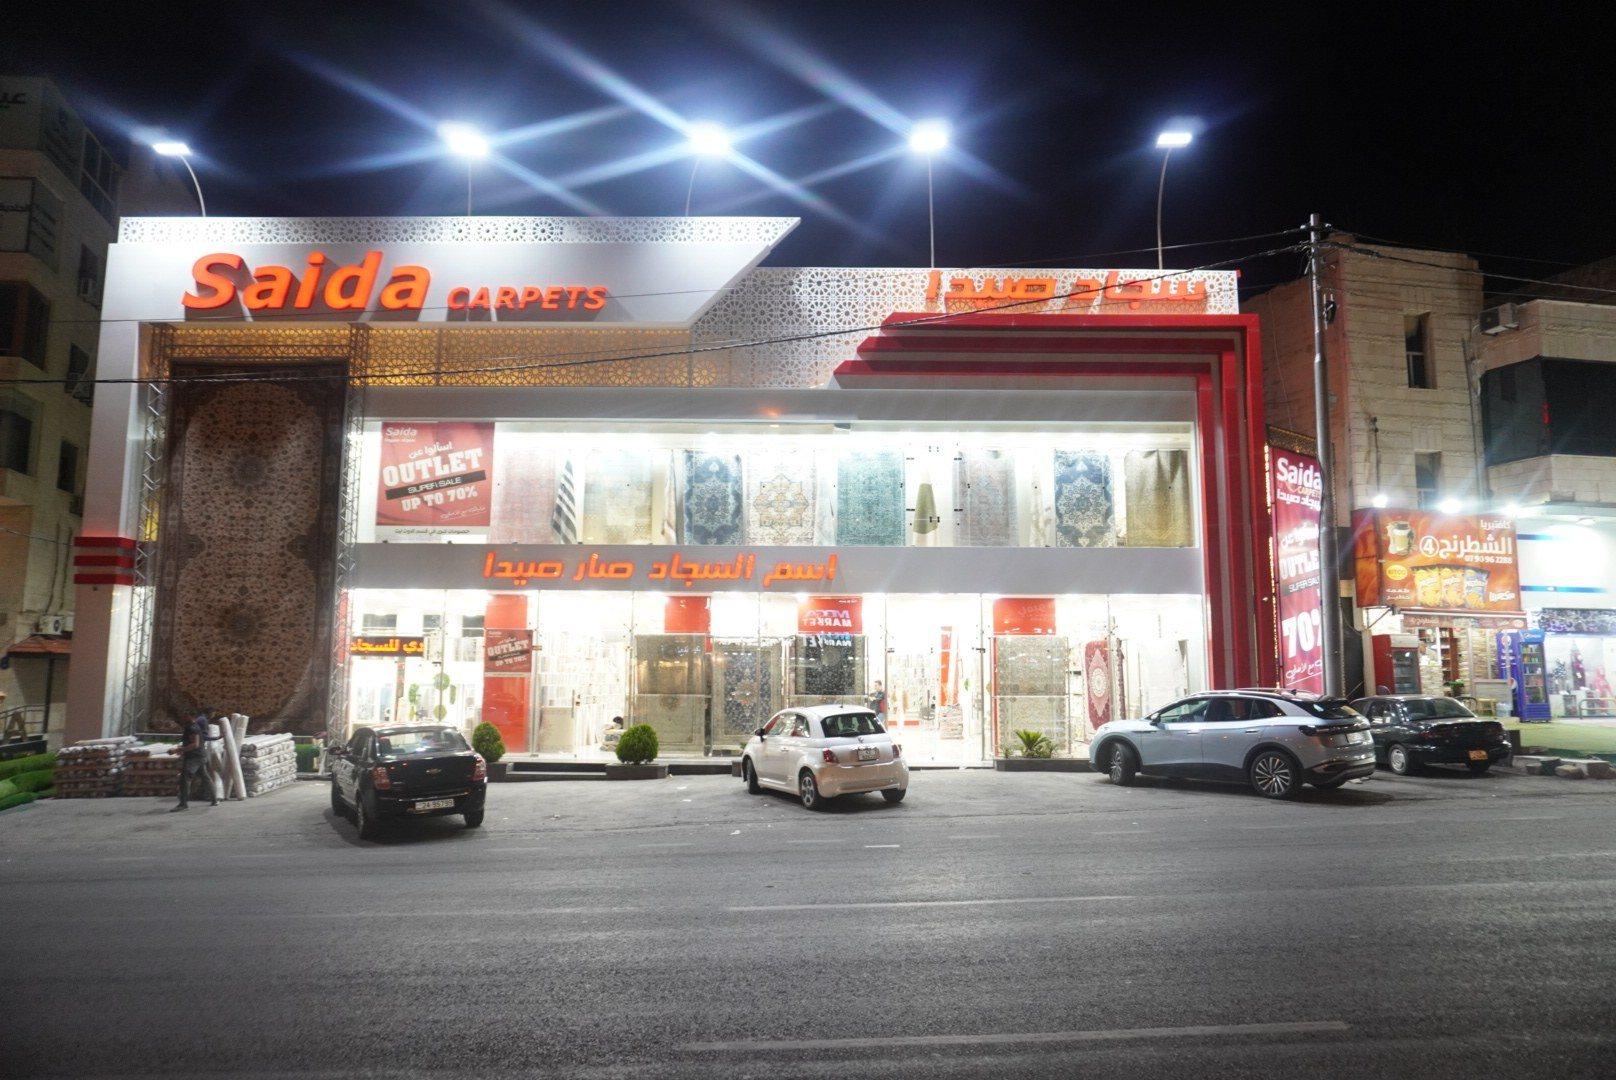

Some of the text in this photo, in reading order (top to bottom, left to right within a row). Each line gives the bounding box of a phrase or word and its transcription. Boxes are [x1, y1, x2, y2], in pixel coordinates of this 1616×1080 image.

[181, 250, 607, 311] Saida CARPETS
[925, 270, 1207, 309] سجاد صيدا
[385, 427, 418, 437] Saida
[382, 447, 483, 487] OUTLET
[1276, 457, 1321, 490] Saida
[401, 486, 478, 511] UP TO 70%
[407, 476, 462, 494] SUPER SALE
[1438, 533, 1513, 559] الشطرنج
[483, 551, 564, 586] صيدا
[648, 552, 756, 587] السجاد
[762, 553, 838, 587] اسم
[1279, 549, 1320, 580] OUTLE
[487, 640, 528, 656] OUTLET
